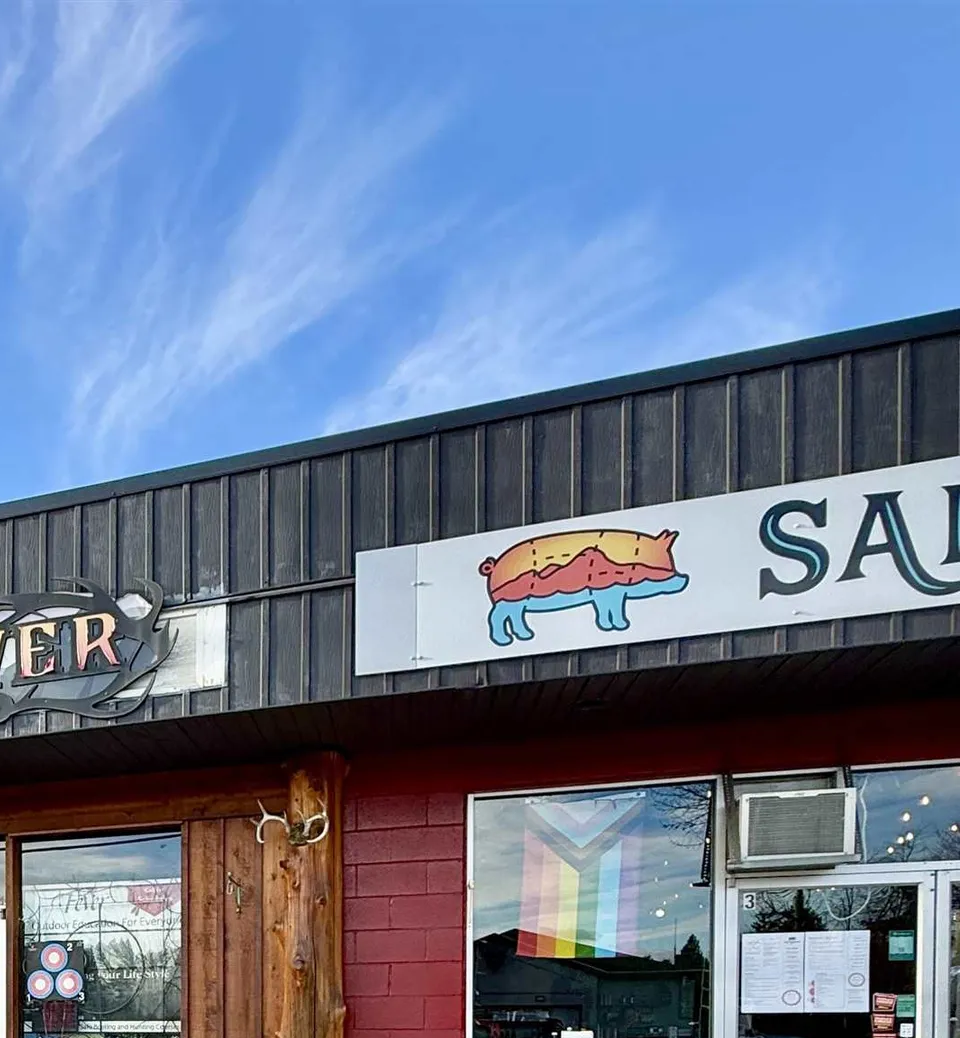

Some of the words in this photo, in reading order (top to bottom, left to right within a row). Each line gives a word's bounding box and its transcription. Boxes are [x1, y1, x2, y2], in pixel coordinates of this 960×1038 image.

[744, 894, 755, 909] 3
[66, 943, 73, 951] 2
[78, 992, 85, 1001] 3
